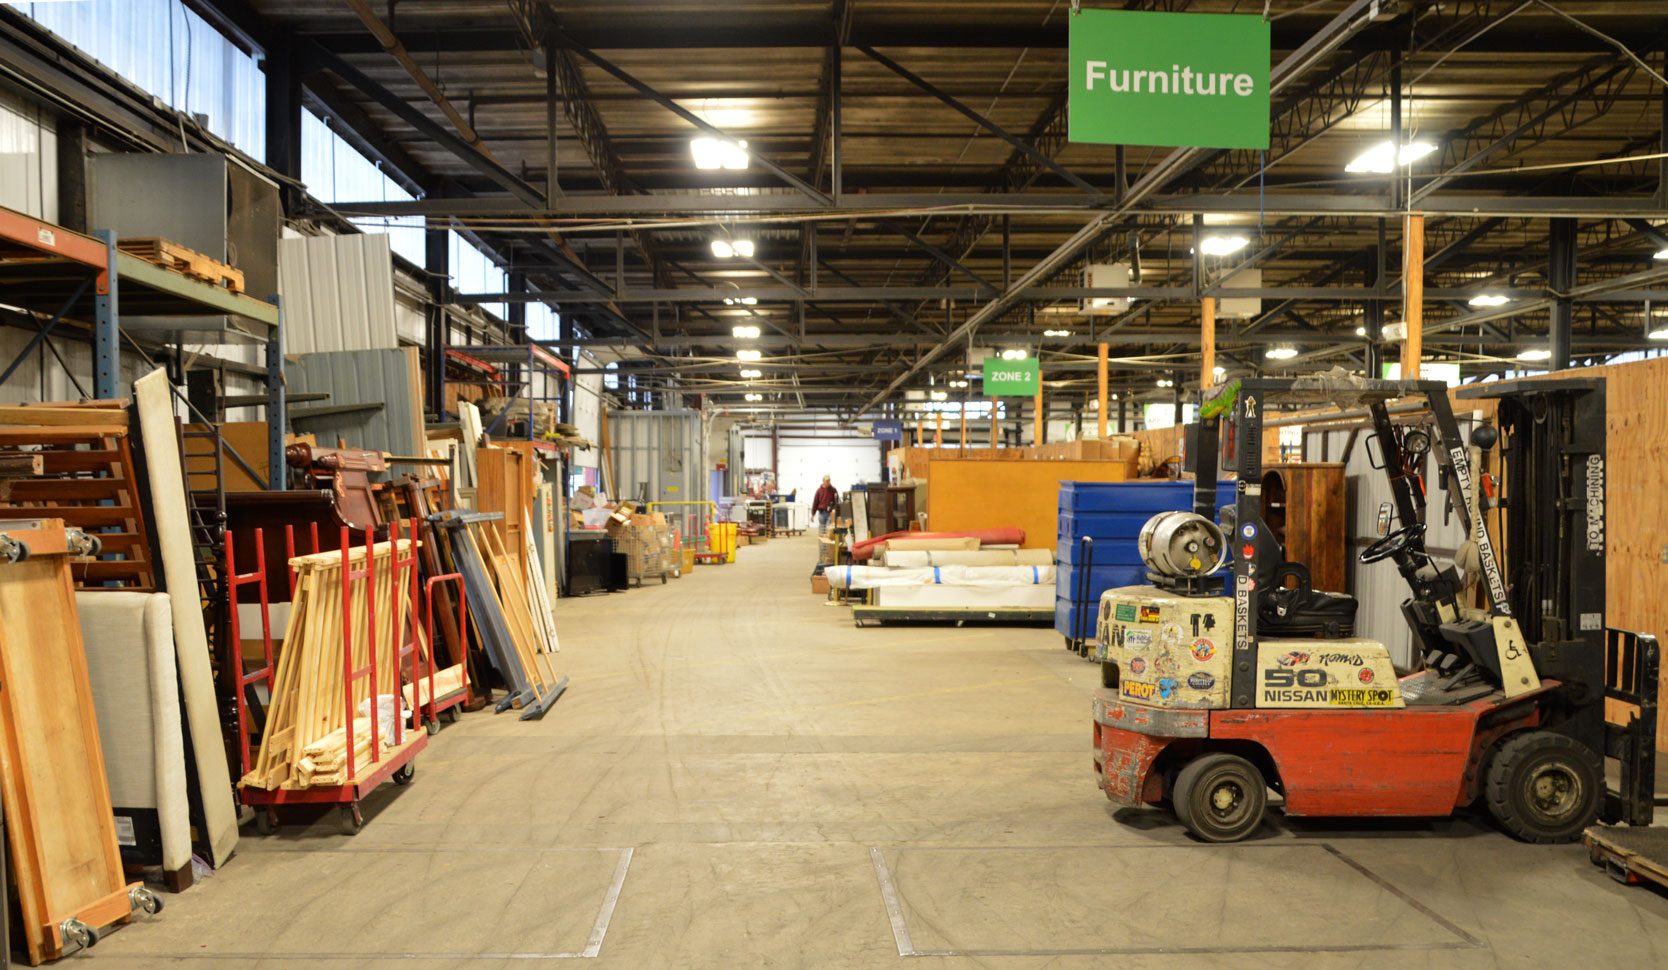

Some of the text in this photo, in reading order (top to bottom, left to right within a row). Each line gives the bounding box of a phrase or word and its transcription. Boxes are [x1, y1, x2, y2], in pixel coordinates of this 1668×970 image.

[1085, 60, 1254, 97] Furniture
[991, 371, 1031, 382] ZONE 2
[1452, 450, 1471, 490] EMPTY
[1479, 542, 1505, 601] BASKETS
[1589, 530, 1599, 547] TO
[1237, 590, 1247, 649] BASKETS
[1264, 668, 1327, 687] 50
[1123, 681, 1155, 697] PEROT
[1264, 690, 1327, 702] NISSAN
[1330, 689, 1393, 702] MYSTERY SPOT
